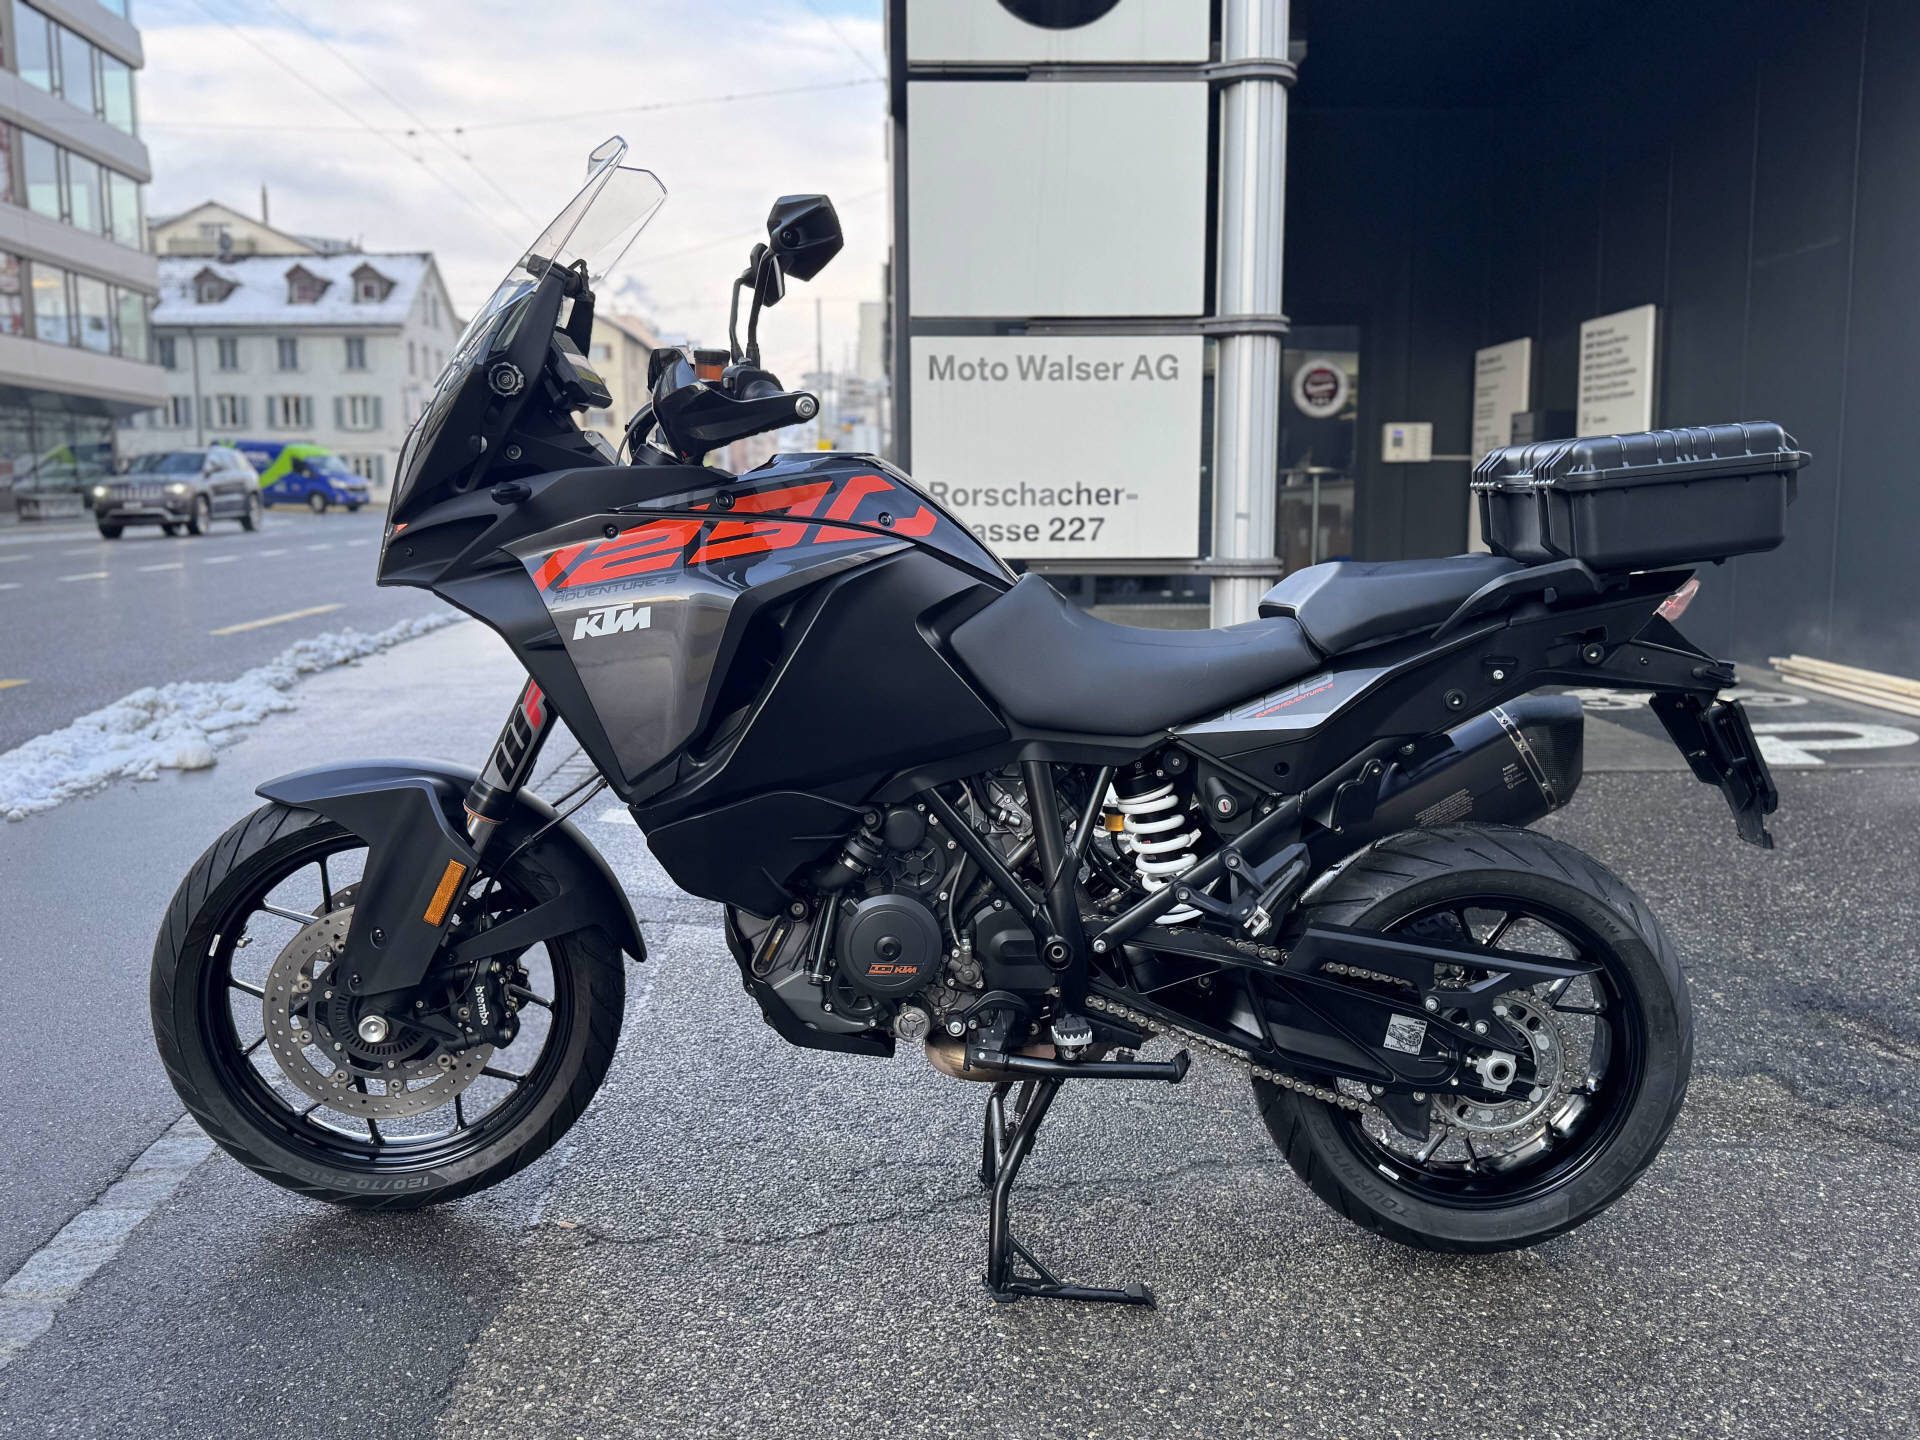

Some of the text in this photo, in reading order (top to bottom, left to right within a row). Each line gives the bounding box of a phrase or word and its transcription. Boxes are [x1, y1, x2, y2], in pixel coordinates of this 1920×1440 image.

[928, 353, 1180, 382] Moto Walser AG
[1048, 516, 1106, 542] 227
[572, 603, 651, 641] KTM
[475, 985, 490, 1026] brembo
[355, 1175, 429, 1191] 120/70
